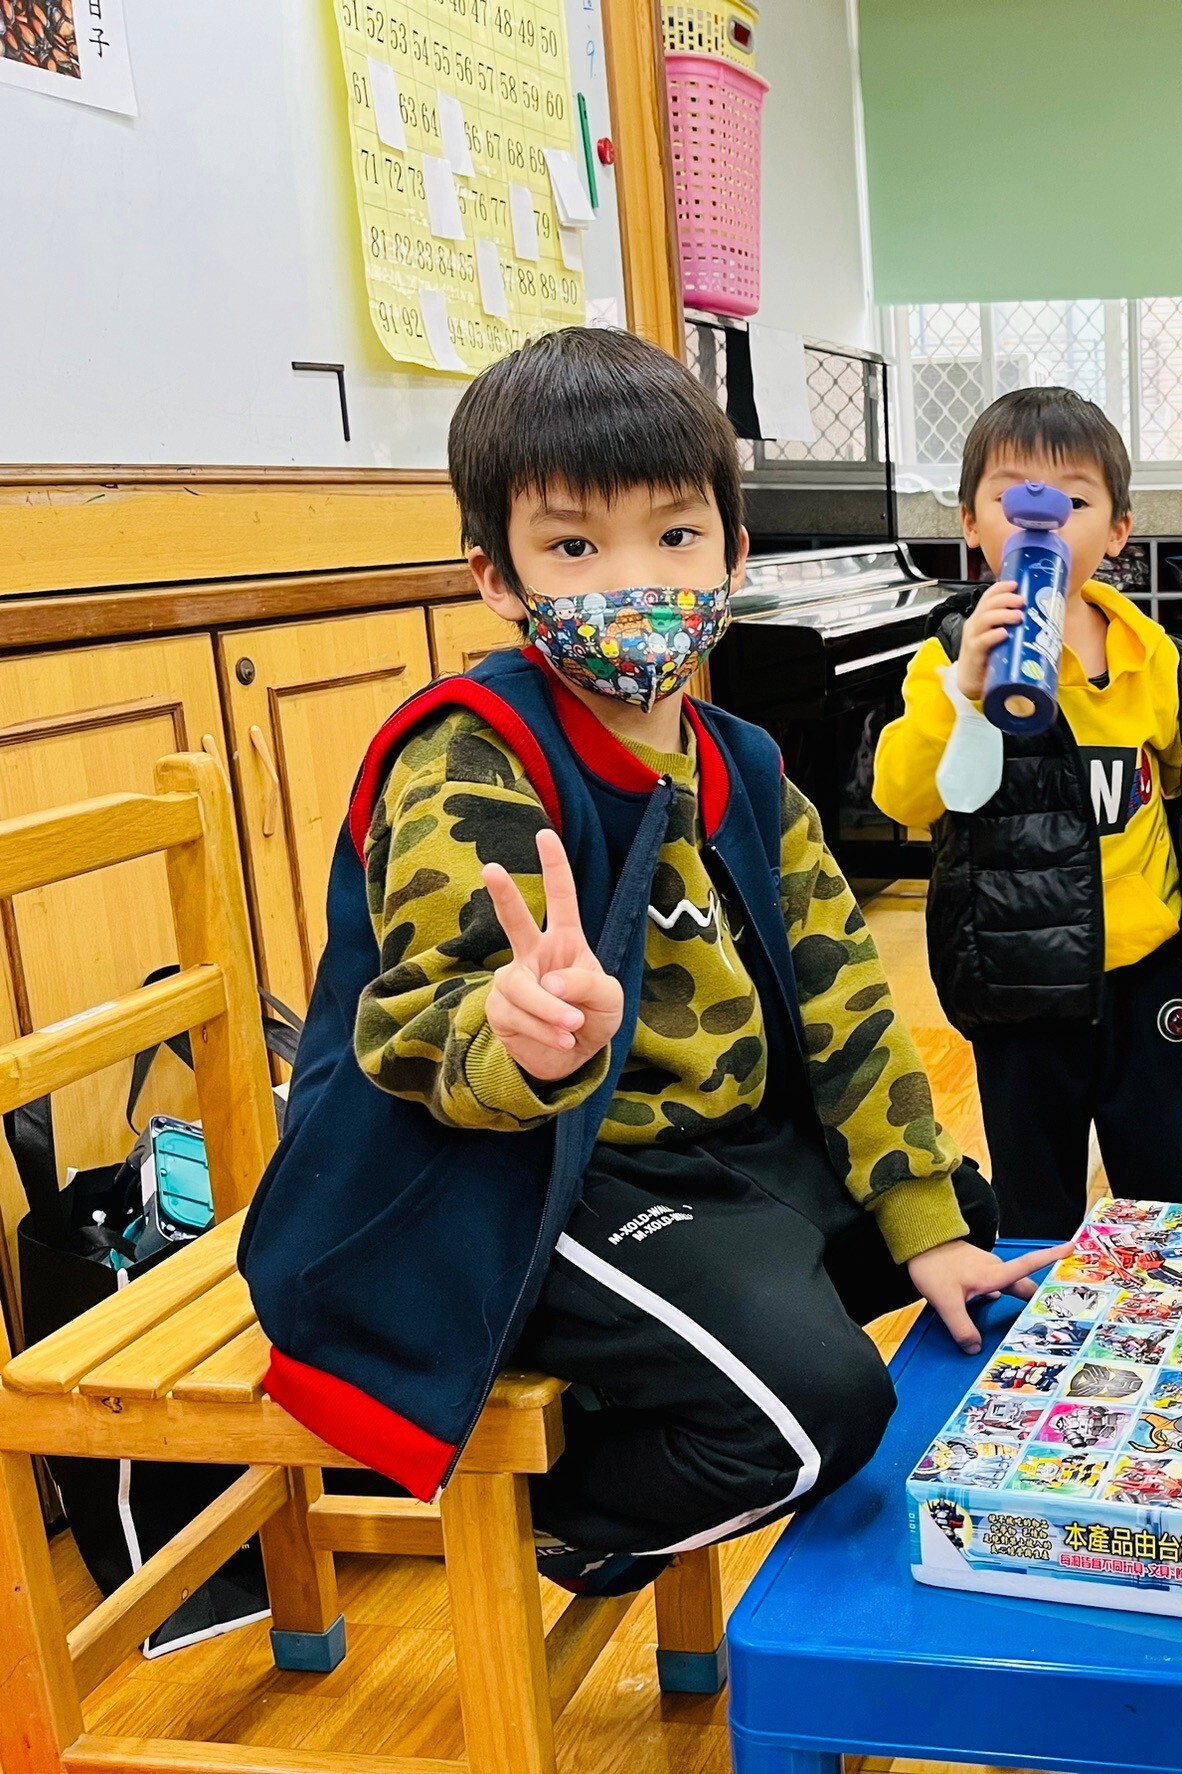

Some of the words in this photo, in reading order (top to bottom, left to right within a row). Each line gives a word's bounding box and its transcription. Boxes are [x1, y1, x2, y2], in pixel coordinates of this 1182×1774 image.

[342, 0, 360, 32] 51
[366, 6, 384, 43] 52
[391, 18, 408, 54] 53
[413, 30, 430, 66] 54
[434, 41, 450, 75] 55
[455, 52, 473, 86] 56
[478, 62, 494, 94] 57
[500, 72, 518, 104] 58
[522, 81, 539, 112] 59
[546, 90, 564, 120] 60
[471, 0, 487, 27] 47
[494, 6, 512, 38] 48
[518, 17, 535, 48] 49
[541, 26, 558, 57] 50
[352, 71, 371, 109] 61
[399, 93, 417, 128] 63
[421, 103, 440, 137] 64
[485, 130, 501, 161] 67
[507, 138, 525, 169] 68
[529, 146, 546, 176] 69
[360, 150, 379, 185] 71
[385, 158, 404, 193] 72
[407, 167, 426, 201] 73
[472, 190, 487, 221] 76
[491, 197, 506, 227] 77
[533, 210, 550, 239] 79
[371, 226, 388, 260] 81
[395, 233, 412, 266] 82
[417, 240, 434, 272] 83
[438, 246, 455, 278] 84
[459, 252, 475, 283] 85
[518, 269, 536, 297] 88
[541, 273, 557, 301] 89
[562, 278, 578, 306] 90
[378, 302, 399, 335] 91
[402, 308, 424, 338] 92
[448, 316, 465, 346] 94
[468, 321, 484, 349] 95
[487, 324, 502, 353] 96
